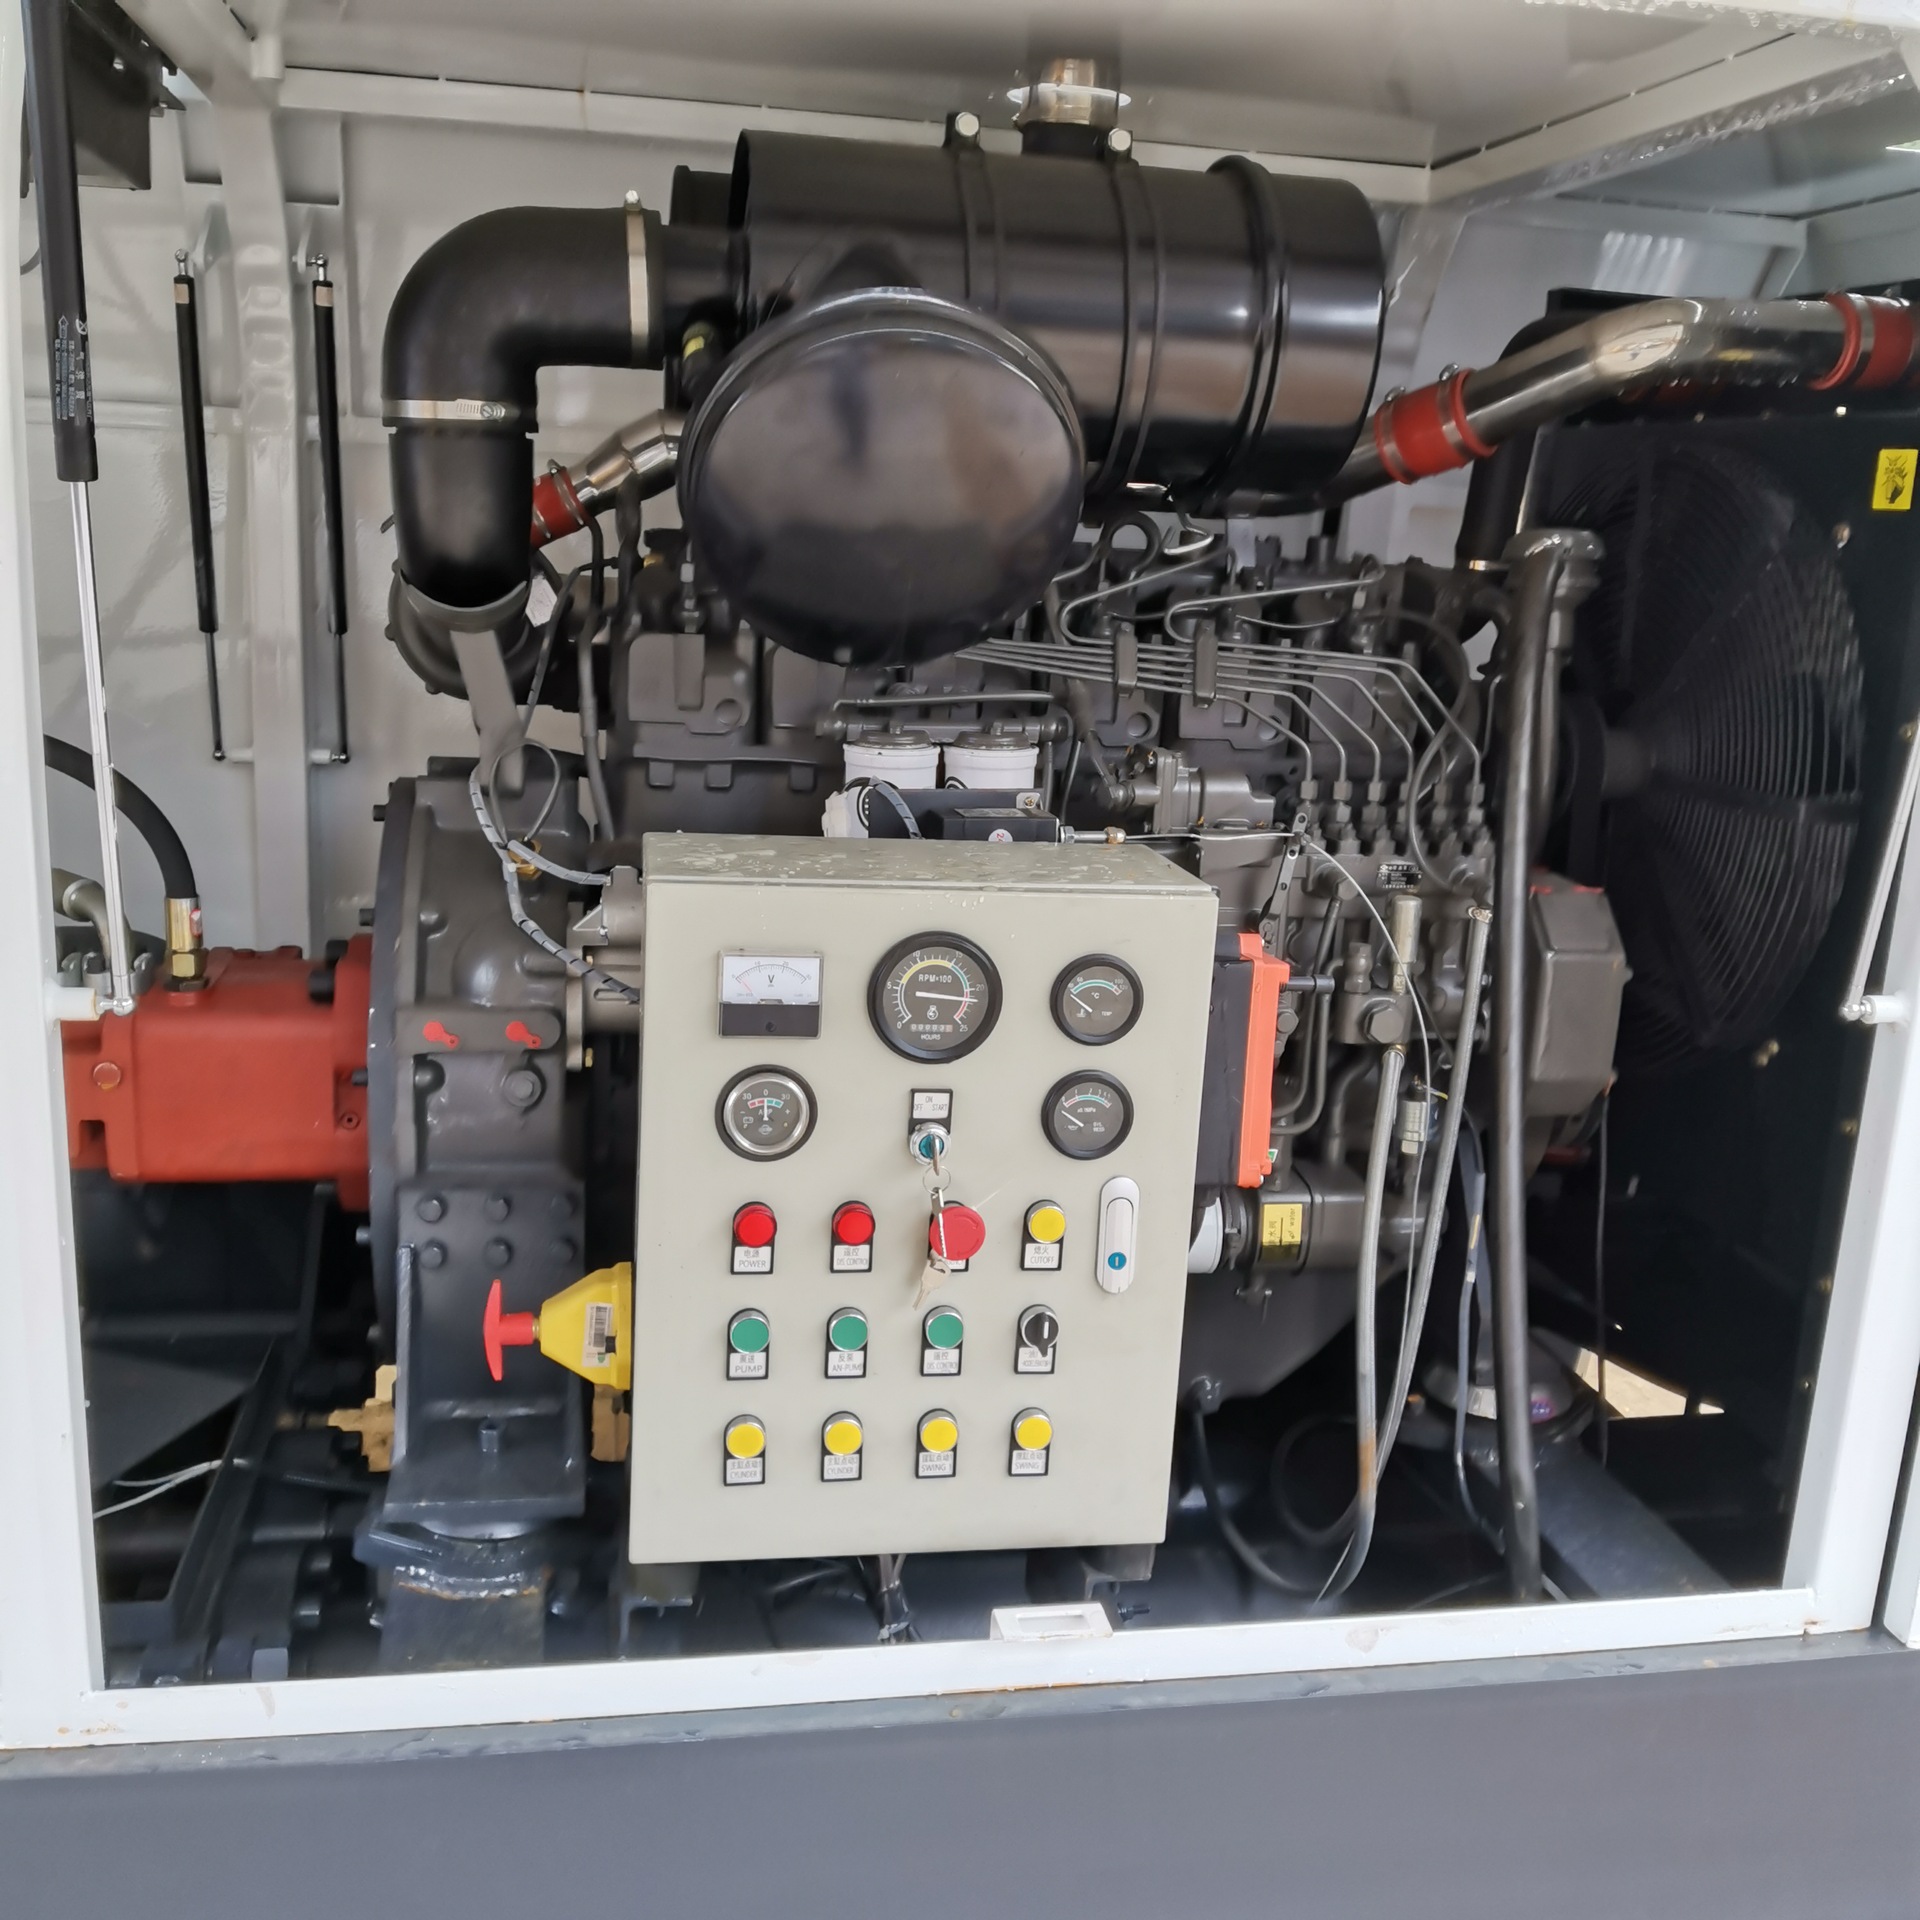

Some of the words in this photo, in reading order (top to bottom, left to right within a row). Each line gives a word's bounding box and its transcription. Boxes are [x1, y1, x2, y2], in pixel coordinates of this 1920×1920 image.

[768, 974, 775, 984] V
[886, 982, 892, 990] 5
[976, 983, 985, 992] 20
[896, 1022, 902, 1030] 0
[960, 1024, 968, 1032] 25
[921, 1033, 941, 1041] HOURS
[742, 1092, 752, 1100] 30
[763, 1088, 769, 1096] 0
[925, 1096, 934, 1104] ON
[932, 1103, 948, 1112] START
[1033, 1245, 1049, 1255] 熄火
[738, 1259, 767, 1268] POWER
[1030, 1255, 1055, 1264] CUTOFF
[734, 1365, 764, 1374] PUMP
[921, 1463, 947, 1472] SWING
[1015, 1461, 1040, 1470] SWING
[730, 1470, 758, 1480] CYLINDER
[826, 1467, 854, 1476] CYLINDER
